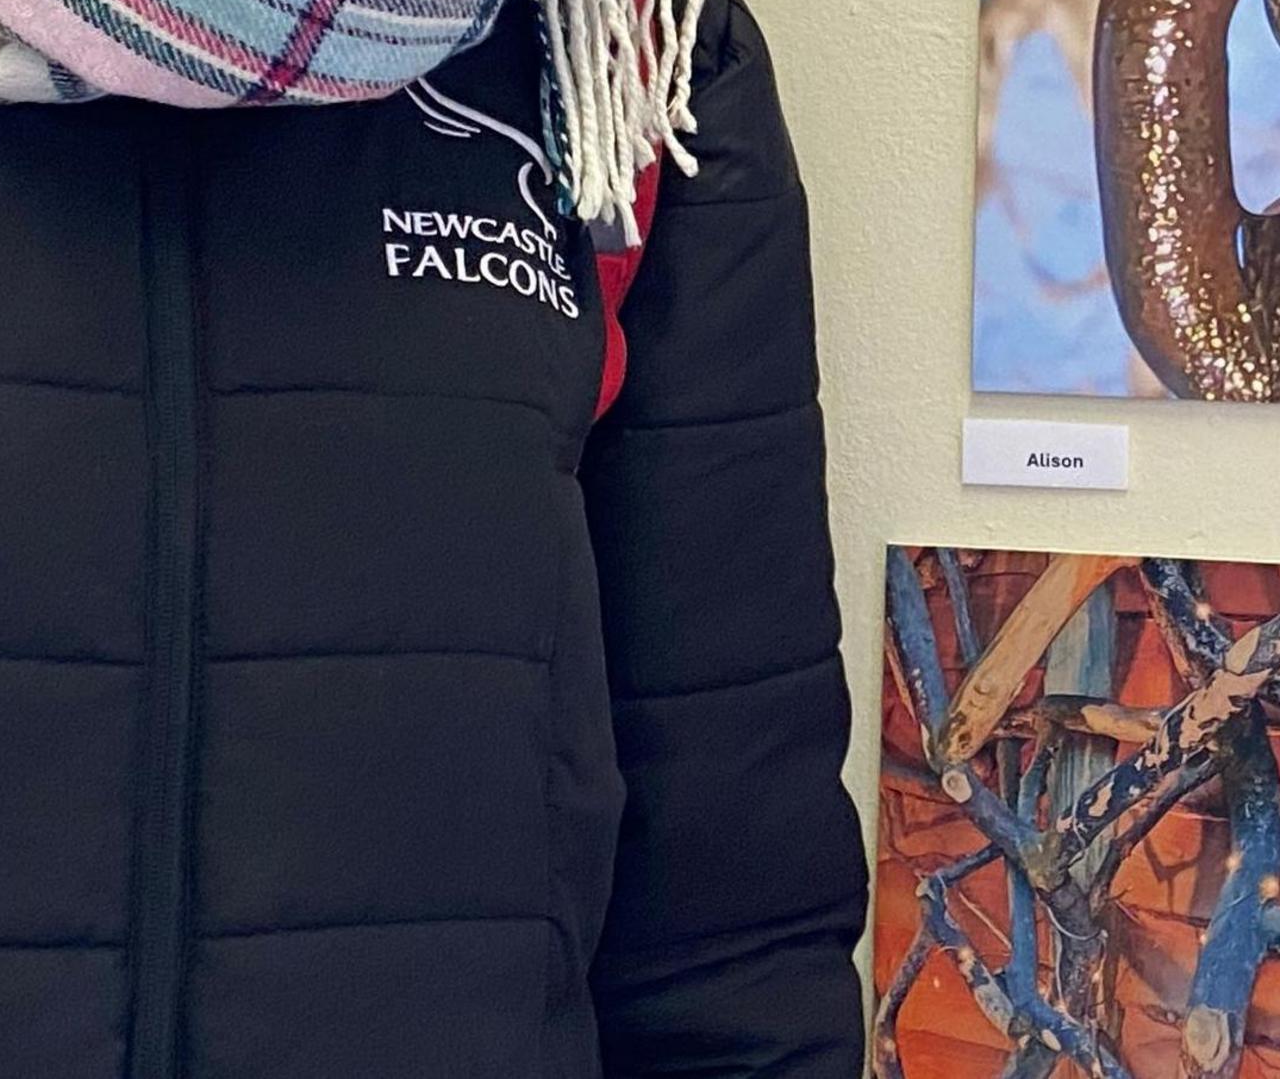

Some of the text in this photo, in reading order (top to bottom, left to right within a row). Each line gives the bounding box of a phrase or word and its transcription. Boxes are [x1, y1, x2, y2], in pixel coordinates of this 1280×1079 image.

[382, 208, 571, 280] NEWCASTLE
[385, 243, 579, 319] FALCONS
[1027, 453, 1084, 468] Alison
